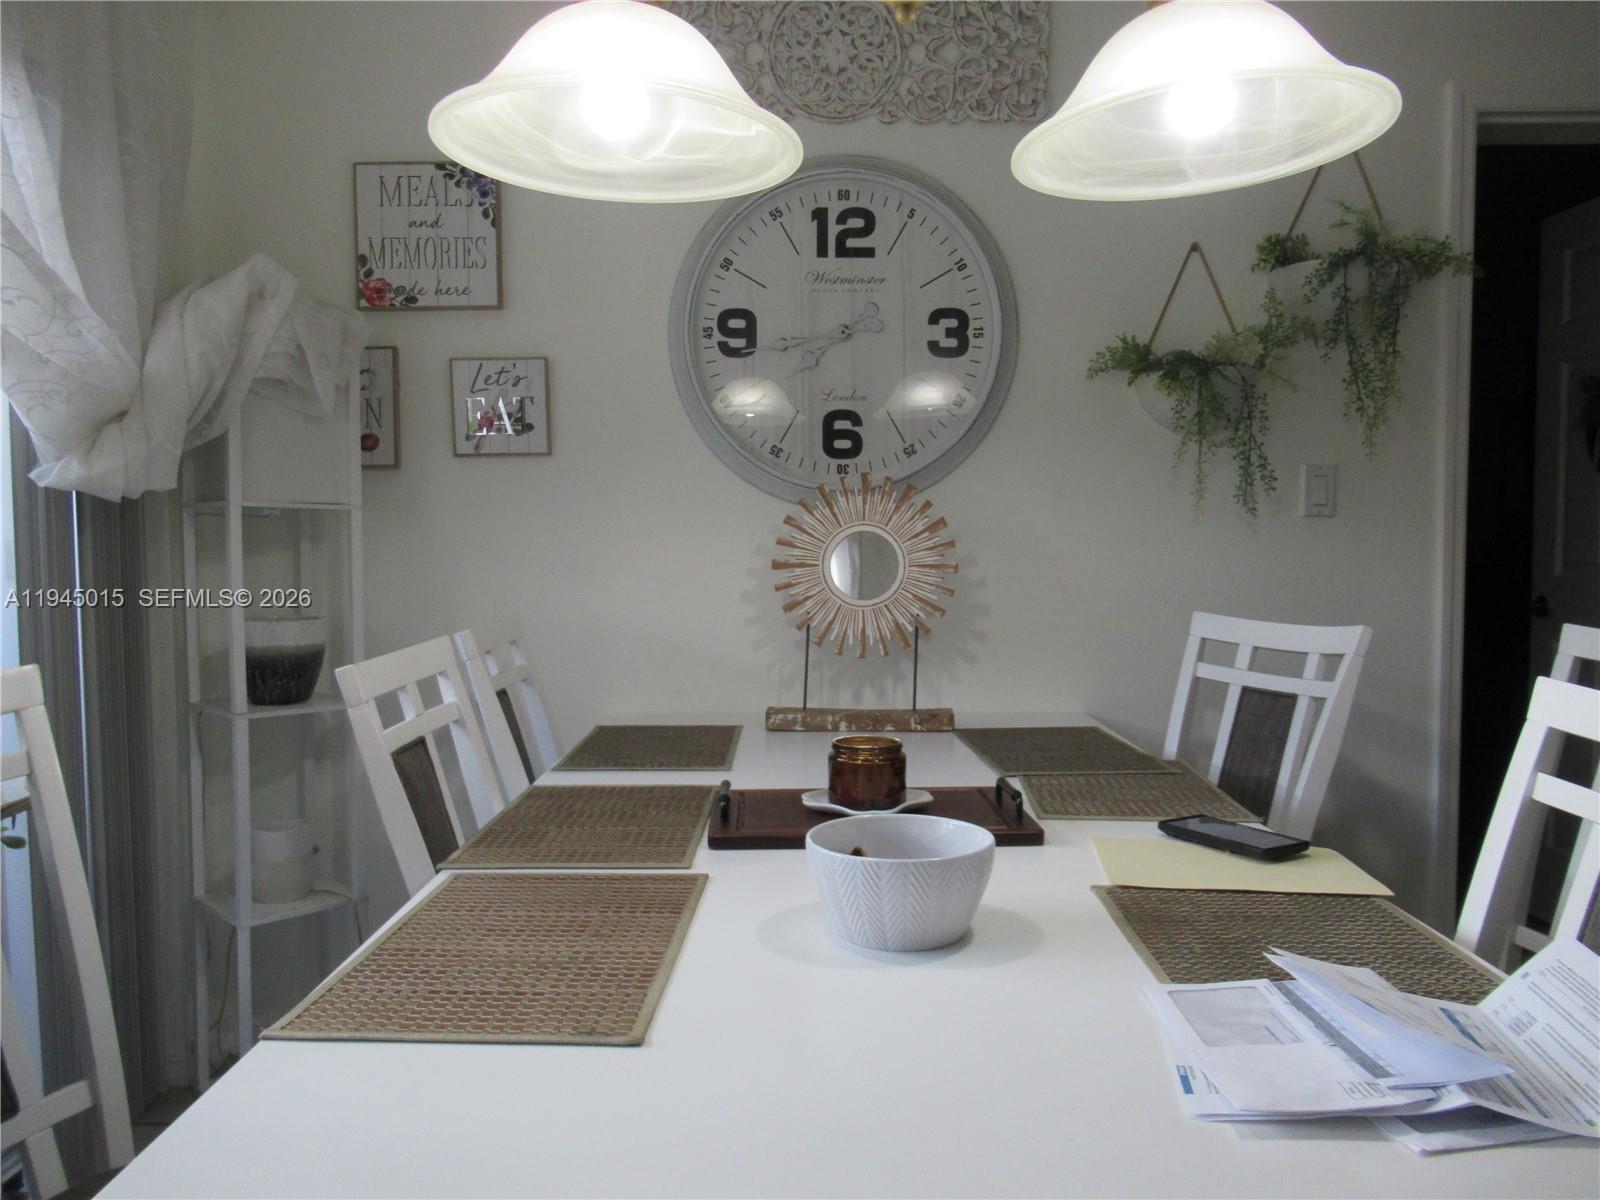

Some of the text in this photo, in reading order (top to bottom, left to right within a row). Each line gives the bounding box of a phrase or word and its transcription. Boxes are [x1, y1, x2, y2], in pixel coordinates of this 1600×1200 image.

[837, 189, 851, 202] 60
[408, 212, 445, 230] and
[768, 206, 784, 221] 55
[906, 207, 917, 220] 5
[811, 206, 877, 258] 12
[367, 235, 488, 270] MEMORIES
[719, 256, 734, 272] 50
[953, 257, 968, 273] 10
[804, 267, 887, 285] Westminster
[433, 279, 473, 297] here
[702, 326, 714, 340] 45
[716, 307, 758, 359] 9
[926, 306, 970, 359] 3
[972, 325, 984, 340] 15
[469, 362, 528, 395] Let's
[463, 396, 535, 436] EAT
[822, 408, 864, 460] 6
[768, 444, 784, 459] 35
[902, 443, 918, 459] 25
[836, 463, 850, 476] 30
